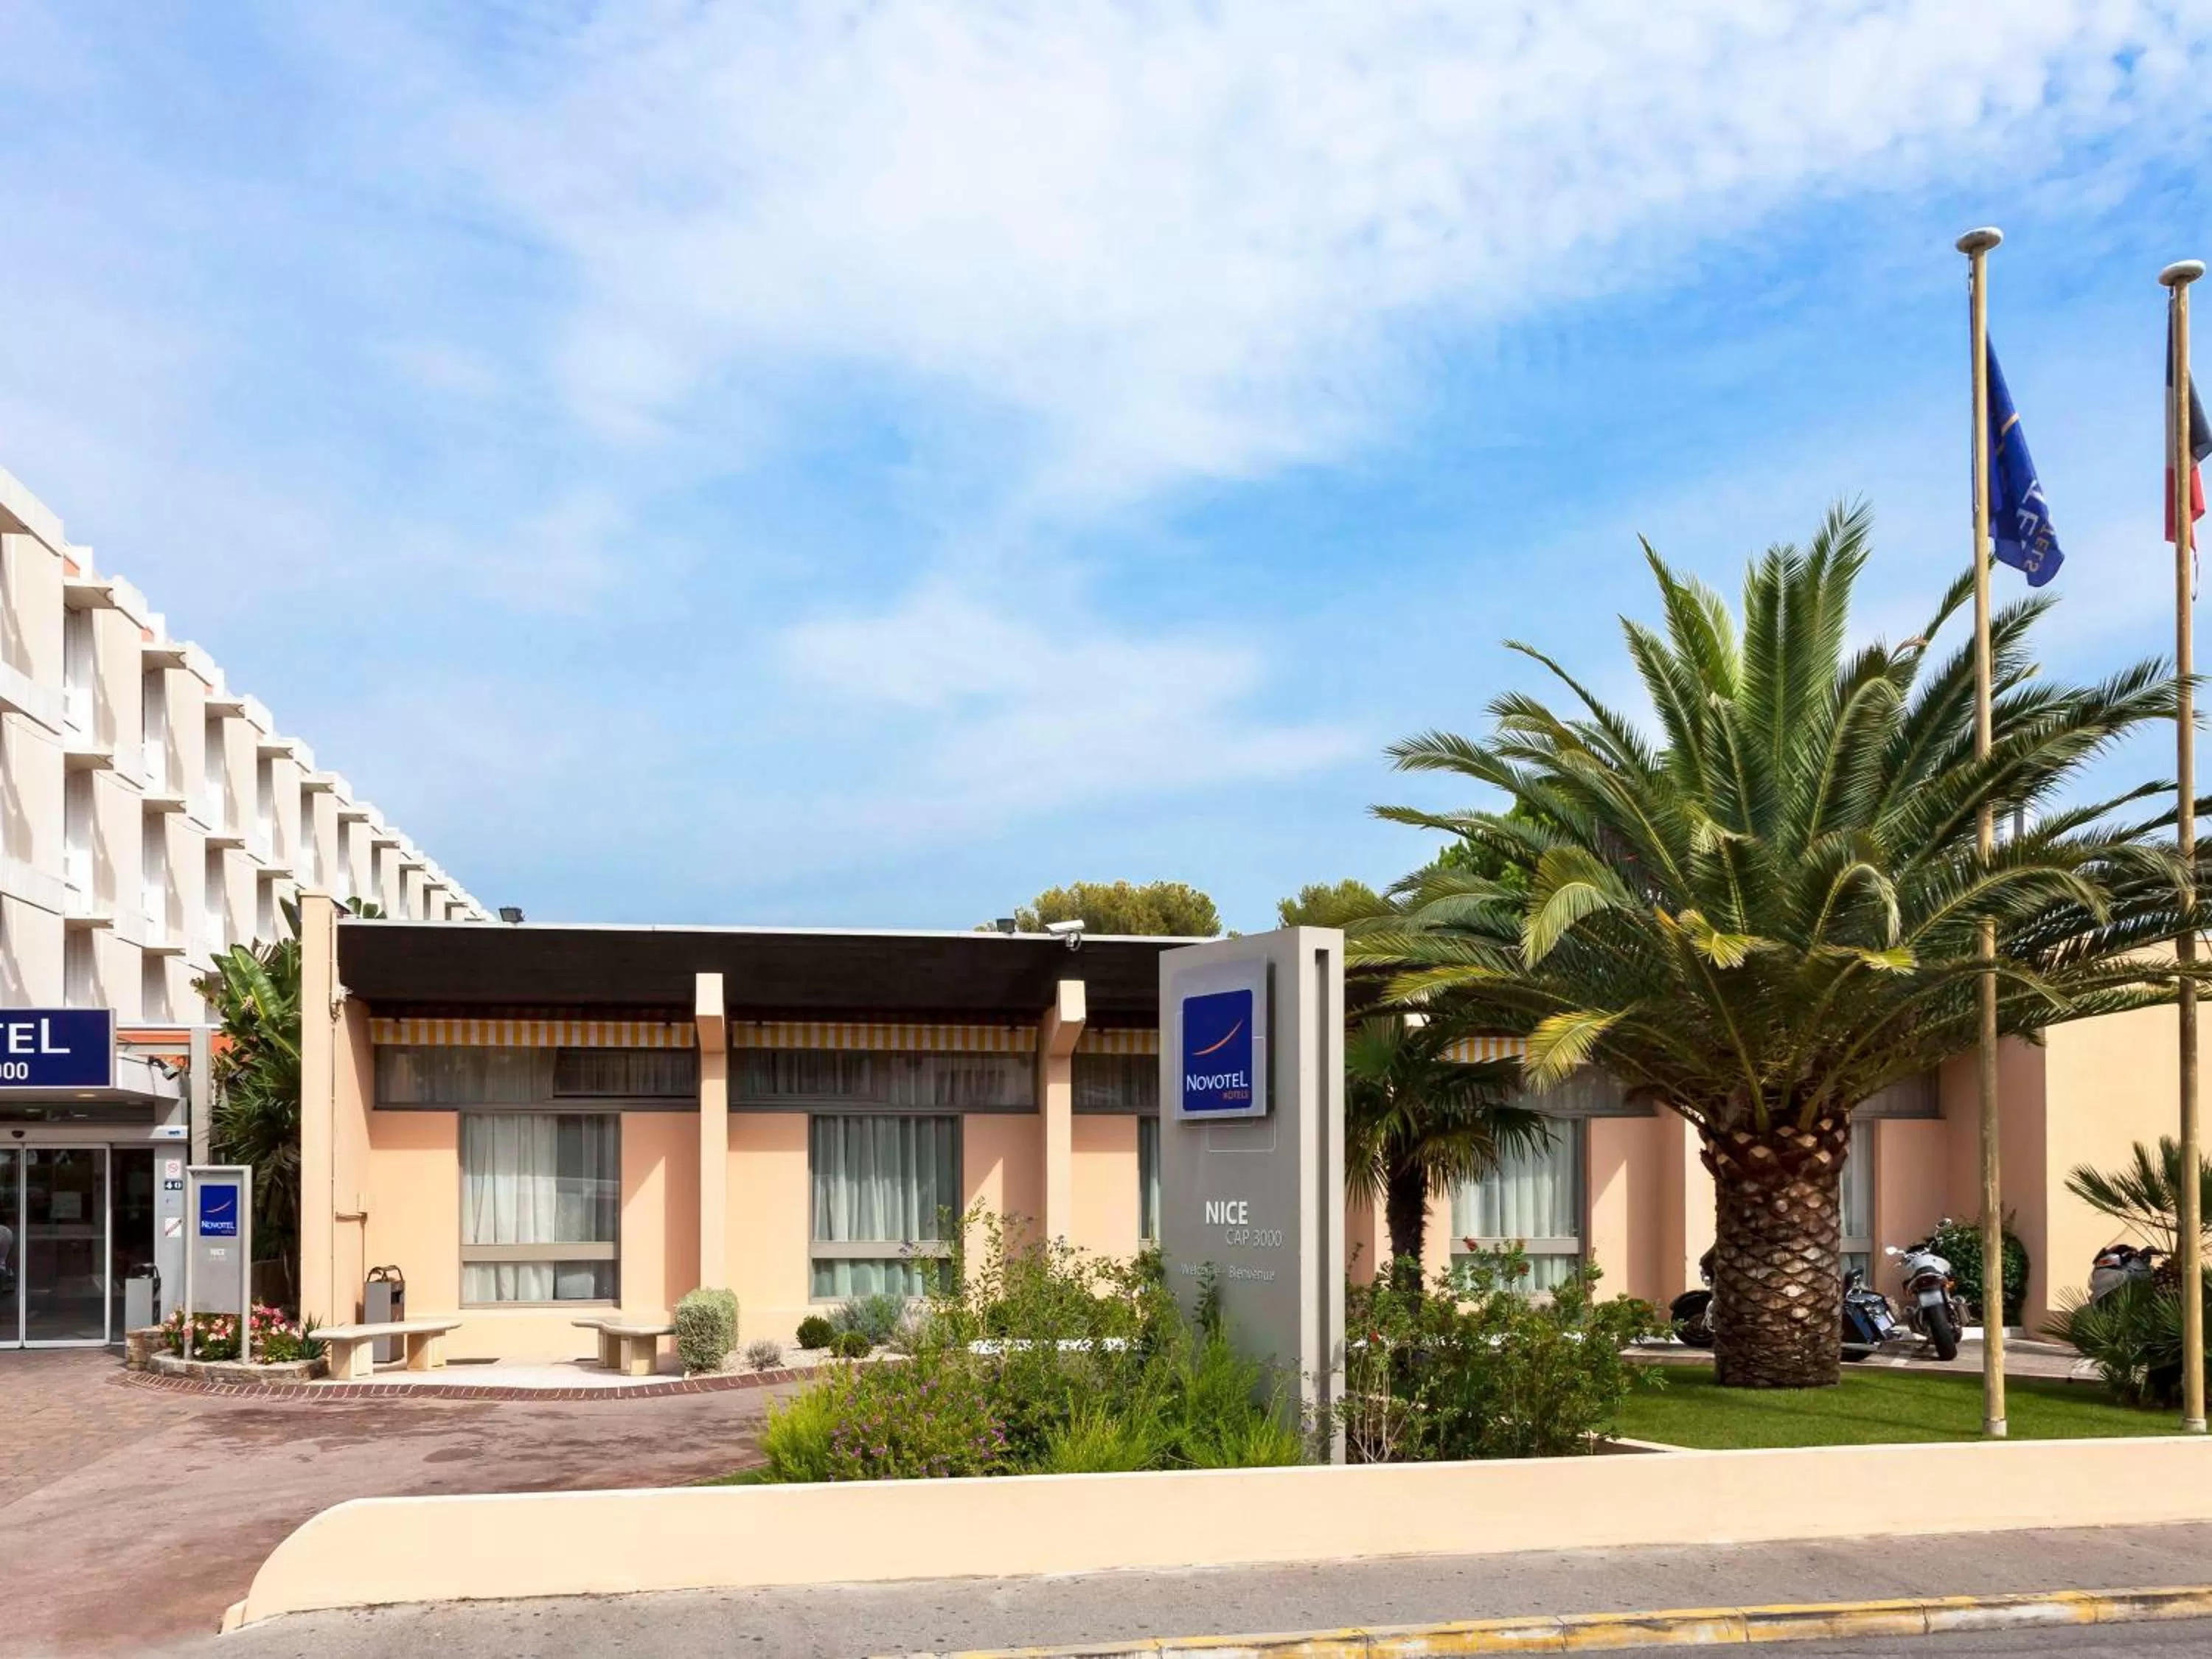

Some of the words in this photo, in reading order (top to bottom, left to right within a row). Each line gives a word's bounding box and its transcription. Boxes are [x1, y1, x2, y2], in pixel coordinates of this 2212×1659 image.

[0, 1062, 29, 1079] 00
[1186, 1070, 1248, 1091] NOVOTEL
[1206, 1201, 1248, 1225] NICE
[201, 1220, 235, 1230] NOVOTEL
[1226, 1228, 1250, 1245] CAP
[1253, 1230, 1282, 1247] 3000
